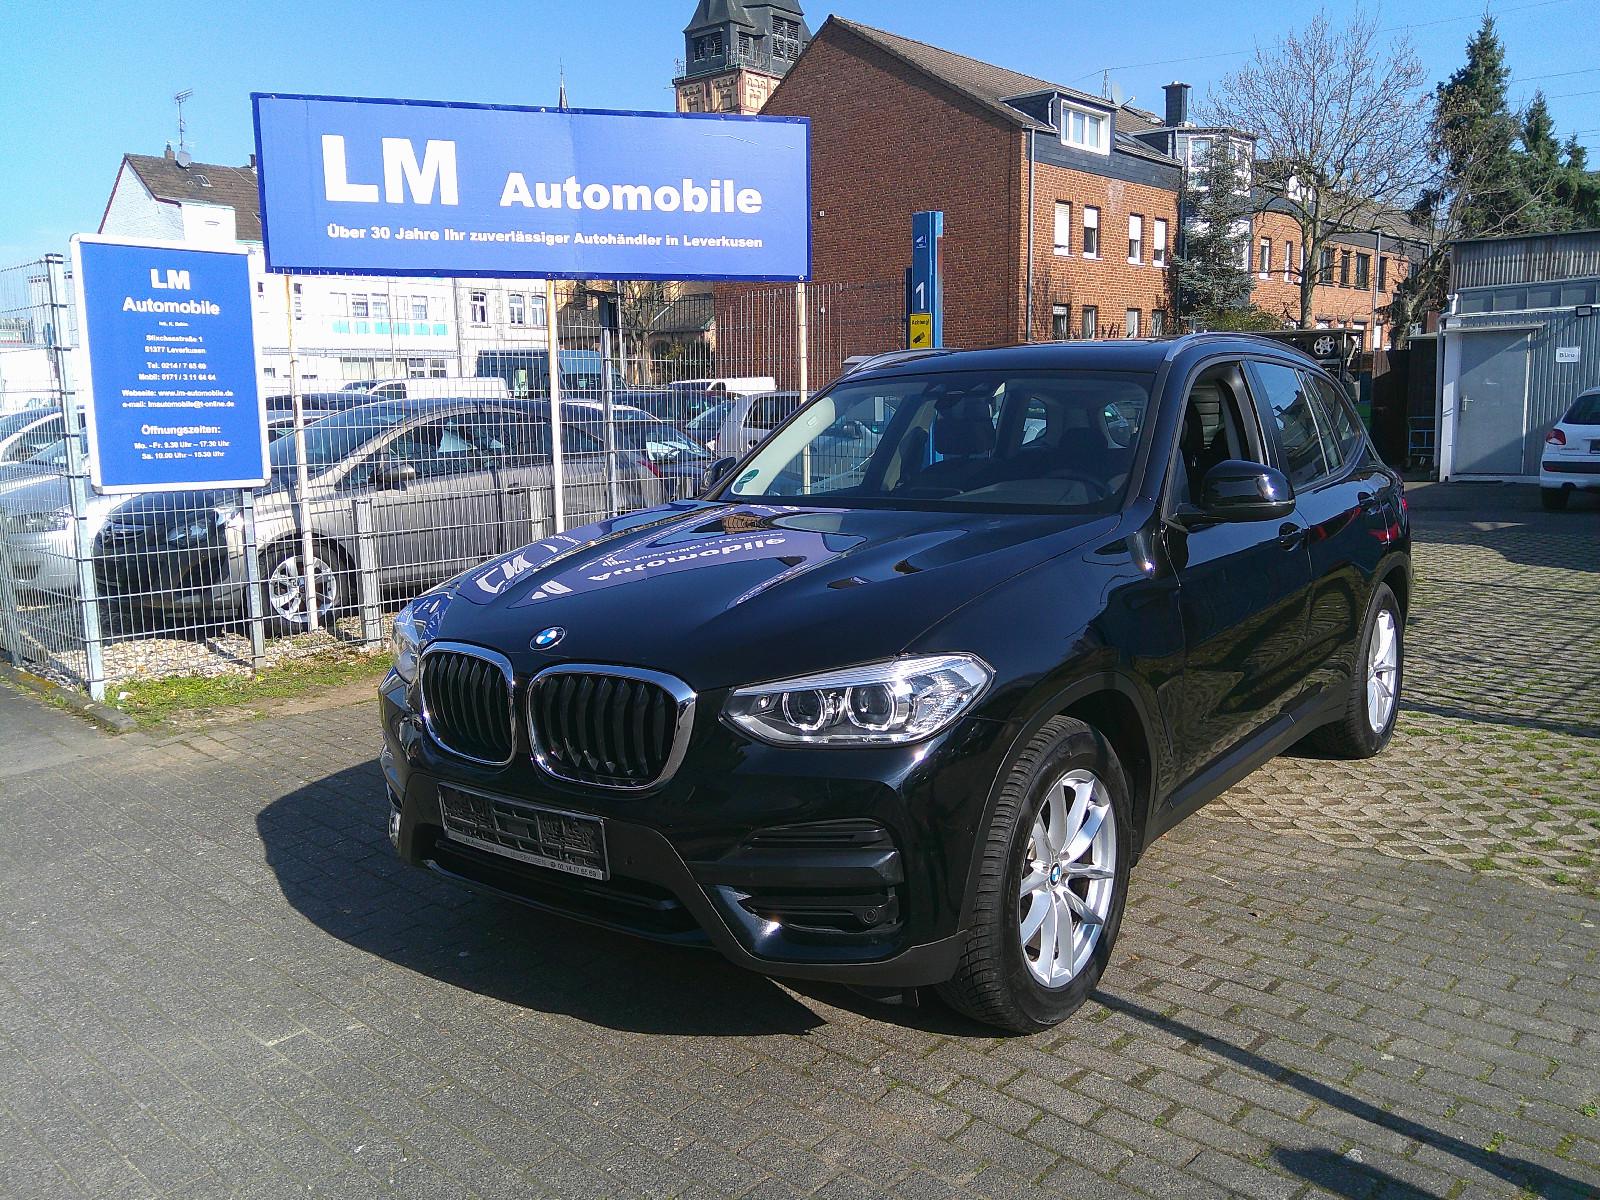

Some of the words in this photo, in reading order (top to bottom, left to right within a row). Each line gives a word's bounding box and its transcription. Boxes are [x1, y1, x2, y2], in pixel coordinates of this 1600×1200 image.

[322, 135, 458, 205] LM
[500, 173, 762, 213] Automobile
[328, 224, 366, 238] Über
[371, 227, 390, 239] 30
[395, 228, 439, 240] Jahre
[445, 229, 465, 240] Ihr
[470, 231, 570, 246] zuverlässiger
[574, 233, 662, 245] Autohändler
[666, 235, 678, 245] in
[684, 235, 762, 247] Leverkusen
[151, 269, 190, 290] LM
[123, 297, 220, 315] Automobile
[916, 282, 924, 309] 1
[141, 425, 220, 436] Öffnungszeiten:
